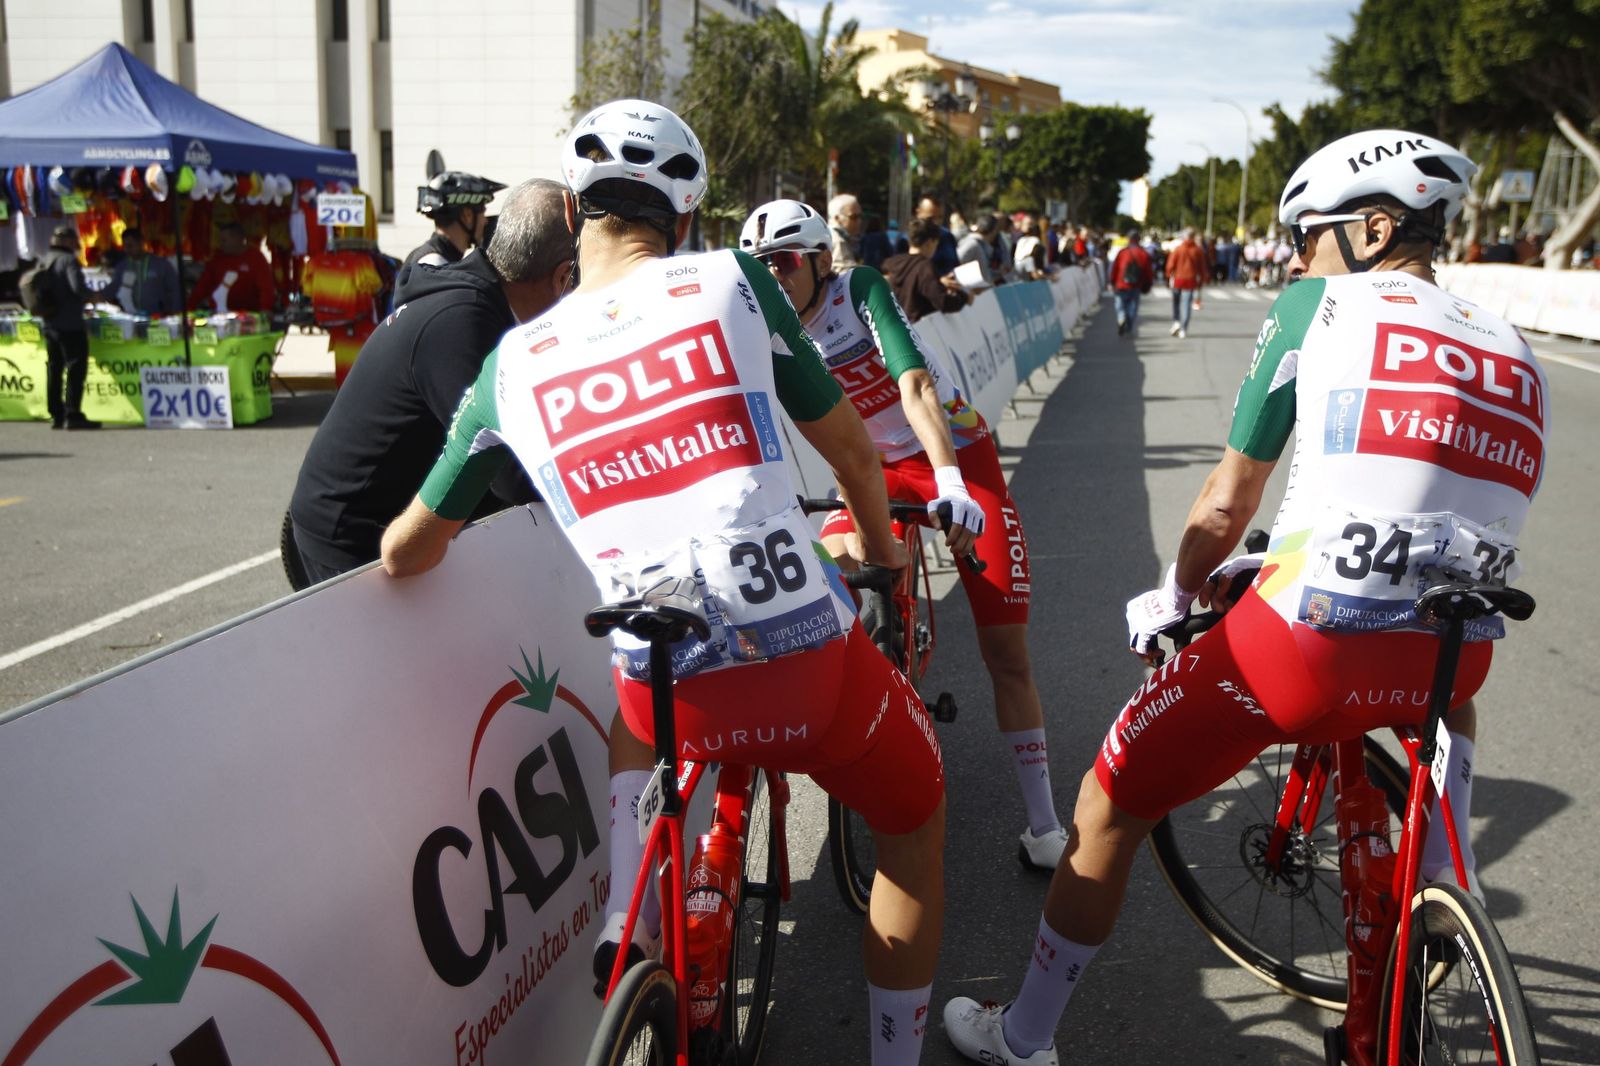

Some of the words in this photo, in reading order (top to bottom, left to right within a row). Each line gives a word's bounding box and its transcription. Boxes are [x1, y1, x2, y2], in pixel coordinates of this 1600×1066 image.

[628, 130, 656, 142] KASK
[1347, 138, 1432, 174] KASK
[666, 266, 698, 279] solo
[1372, 280, 1408, 288] solo
[524, 321, 553, 339] solo
[542, 334, 726, 434] POLTI
[1384, 332, 1544, 420] POLTI
[148, 388, 228, 417] 2x10€
[755, 396, 774, 443] CLIVET
[1336, 406, 1348, 452] CLIVET
[1377, 409, 1536, 479] VisitMalta
[567, 421, 749, 496] VisitMalta
[1001, 507, 1026, 578] POLTI
[1335, 522, 1412, 586] 34
[729, 528, 807, 605] 36
[767, 609, 834, 643] DIPUTACIÓN
[790, 623, 837, 649] ALMERÍA
[1336, 606, 1409, 622] DIPUTACIÓN
[1120, 685, 1185, 744] VisitMalta
[1345, 689, 1455, 706] AURU
[682, 723, 808, 755] AURUM
[644, 784, 660, 827] 36
[412, 726, 600, 988] CASI
[455, 920, 571, 1066] Especialistas
[573, 901, 591, 937] en
